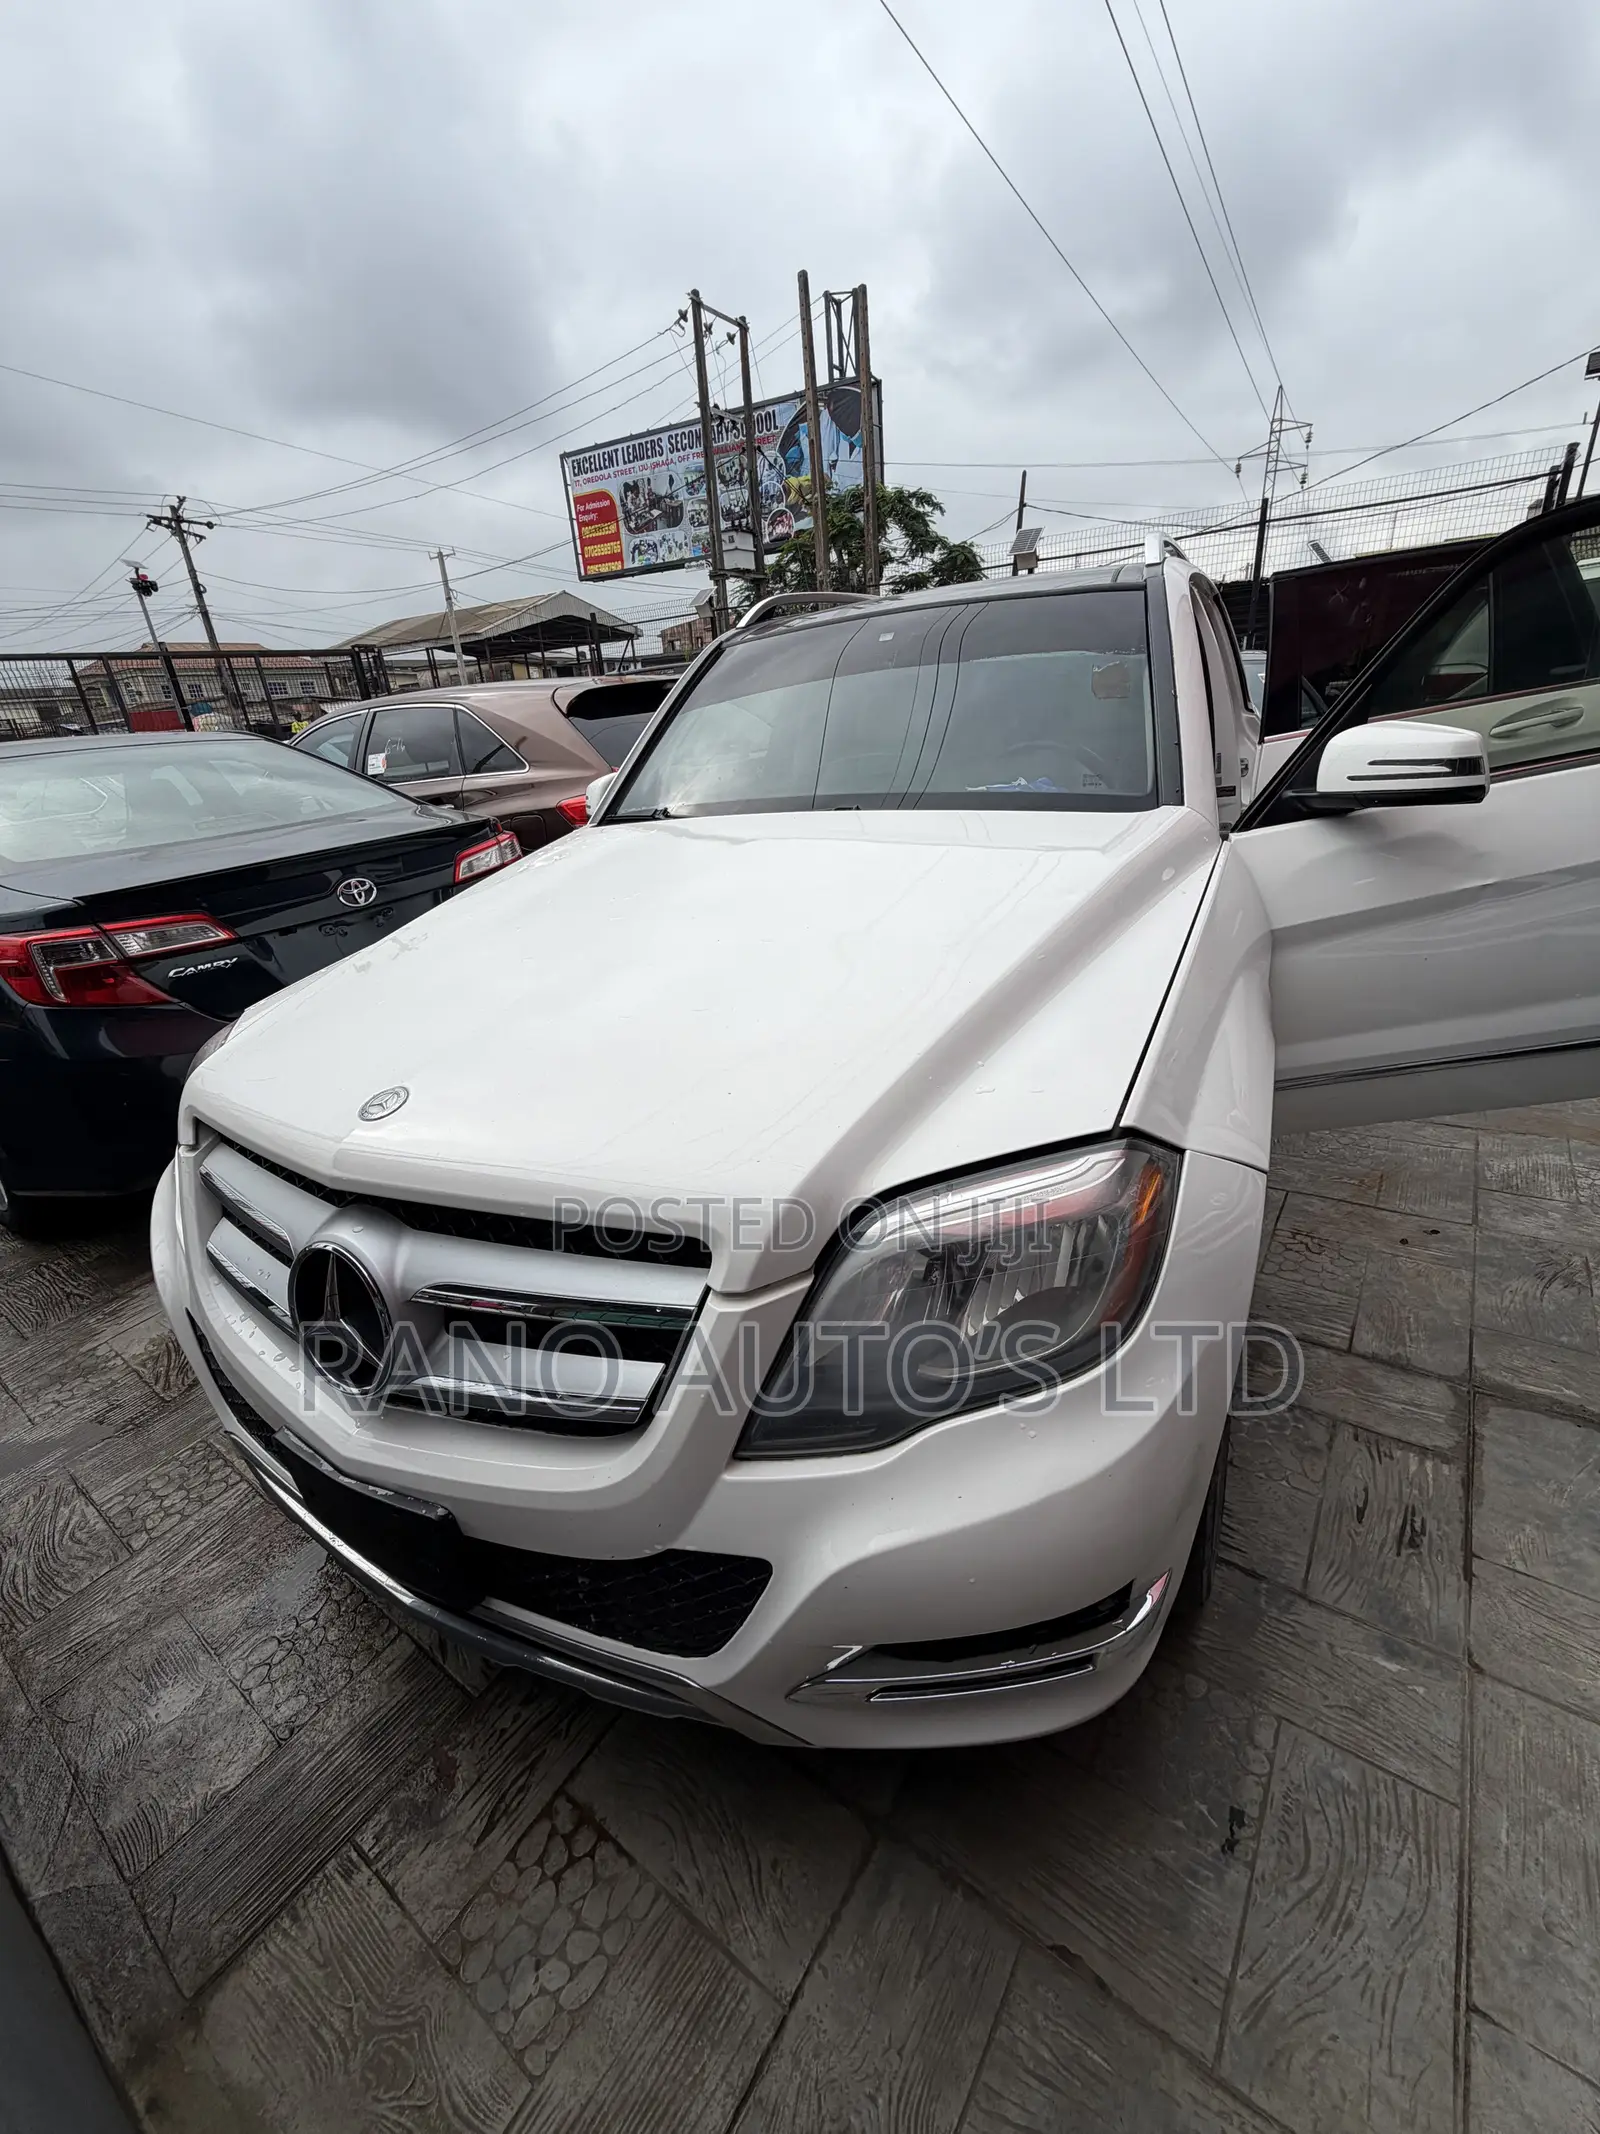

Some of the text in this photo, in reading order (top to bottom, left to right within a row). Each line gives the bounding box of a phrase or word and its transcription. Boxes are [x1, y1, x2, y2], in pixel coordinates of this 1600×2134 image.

[571, 448, 620, 478] EXCELLENT
[622, 437, 664, 466] LEADERS
[667, 420, 730, 455] SECONARY
[582, 474, 612, 486] OREDOLA
[677, 453, 692, 464] OFF
[576, 499, 611, 513] For Admission
[578, 512, 599, 524] Enquiry:
[167, 956, 238, 979] CAMRY
